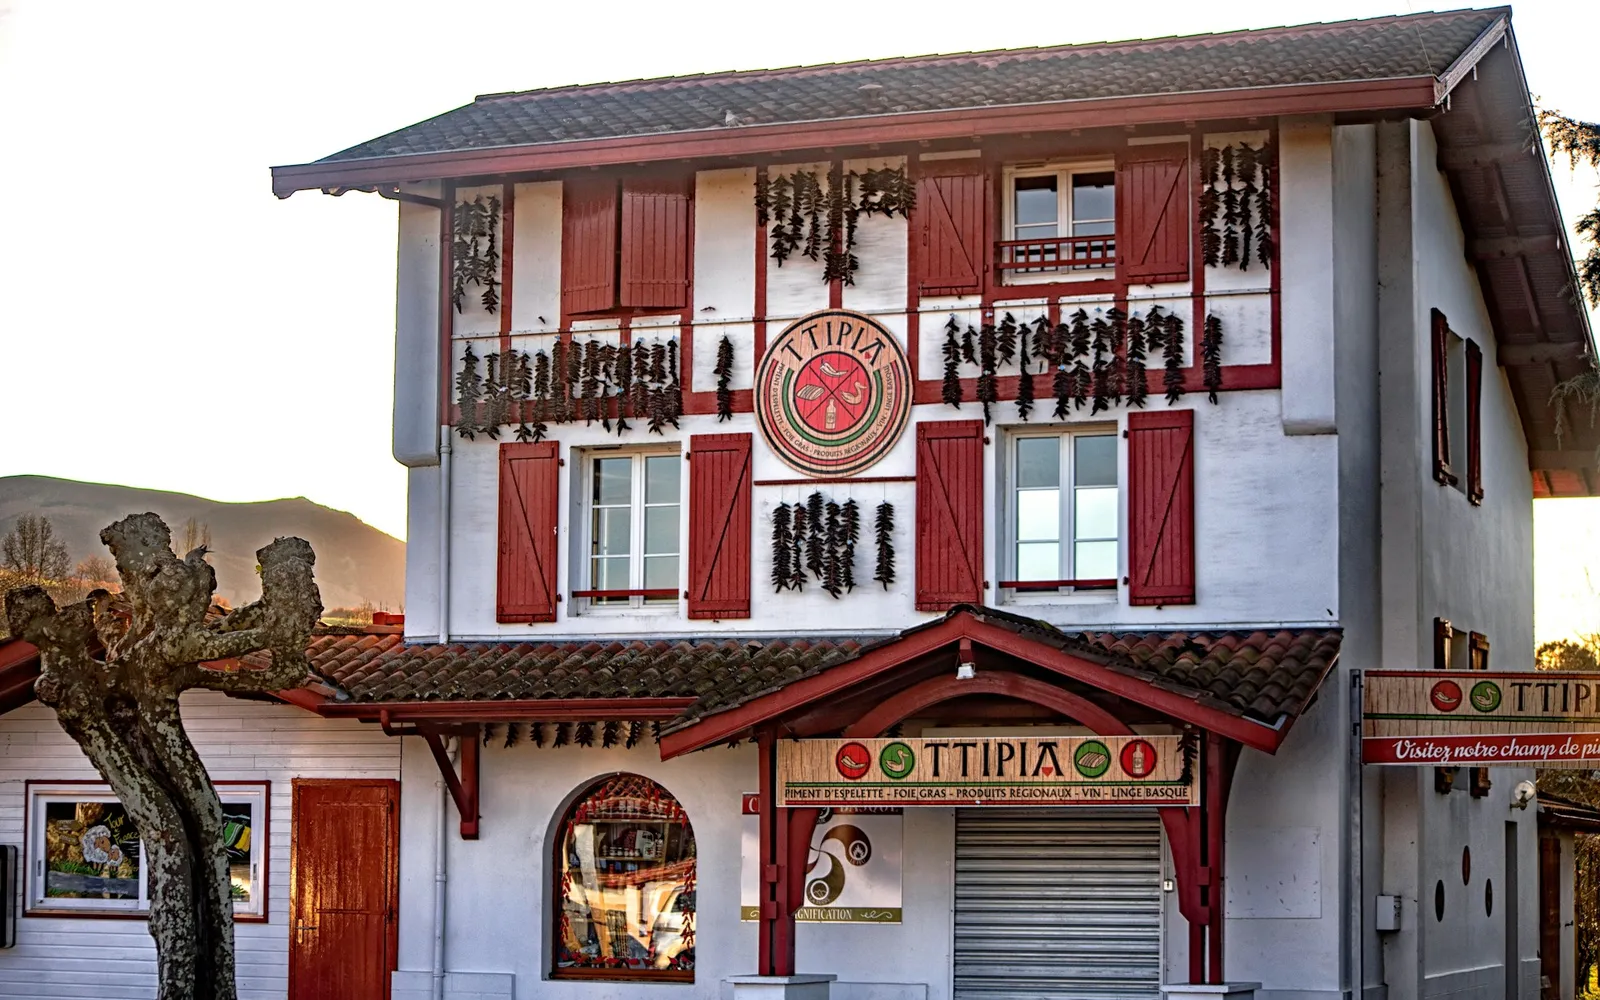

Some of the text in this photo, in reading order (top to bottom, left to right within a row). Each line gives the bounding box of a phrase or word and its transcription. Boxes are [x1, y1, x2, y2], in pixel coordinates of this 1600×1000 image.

[781, 321, 885, 366] TTIPIA
[794, 440, 809, 451] GRAS
[1392, 737, 1600, 763] Visitez notre champ de pi
[924, 742, 1064, 777] TTIPIA
[785, 786, 1188, 798] PIMENT D'ESPELETTE FOIE GRAS PRODUITS RÉGIONAUX VIN LINGE BASQUE
[103, 812, 125, 829] Tour
[795, 909, 852, 920] IGNIFICATION
